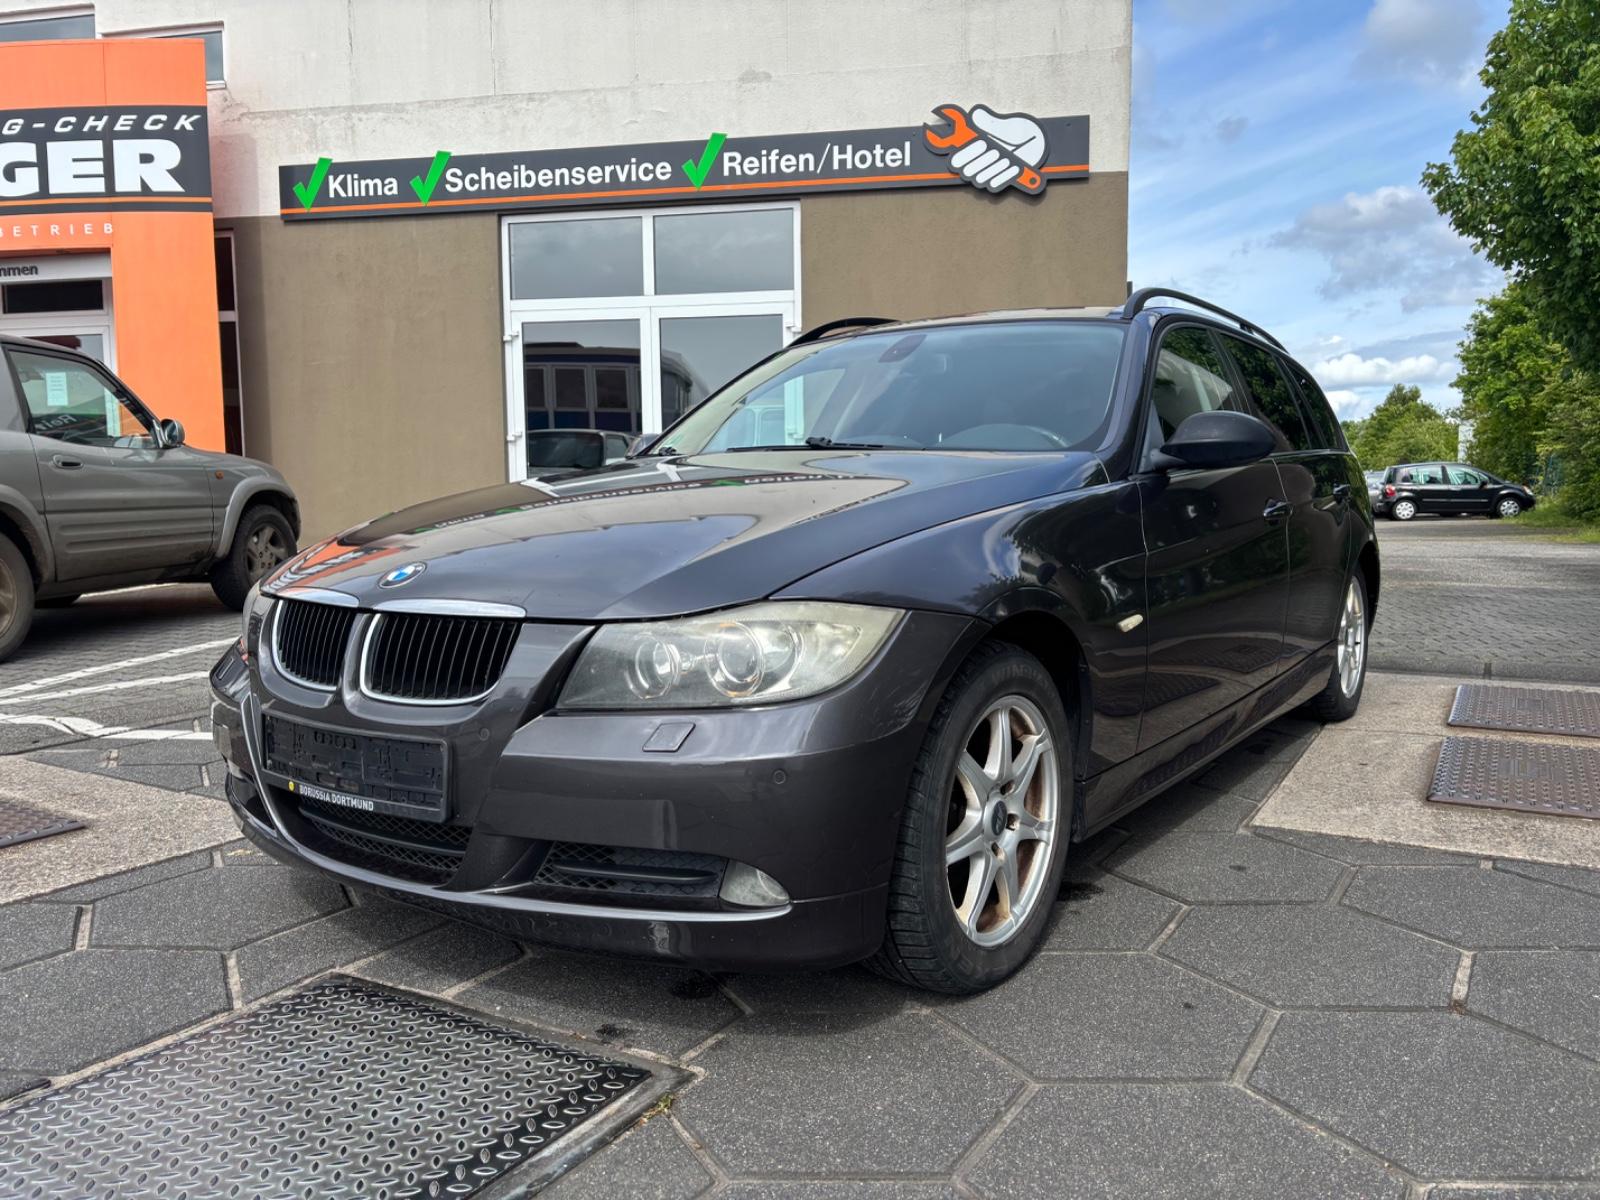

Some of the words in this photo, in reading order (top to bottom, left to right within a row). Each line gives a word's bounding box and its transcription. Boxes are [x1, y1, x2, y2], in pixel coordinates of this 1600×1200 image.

[2, 114, 201, 135] G-CHECK
[0, 138, 185, 197] GER
[327, 174, 398, 199] Klima
[444, 157, 673, 194] Scheibenservice
[723, 141, 911, 177] Reifen/Hotel
[299, 784, 330, 803] BORUSSIA
[331, 793, 374, 812] DORTMUND
